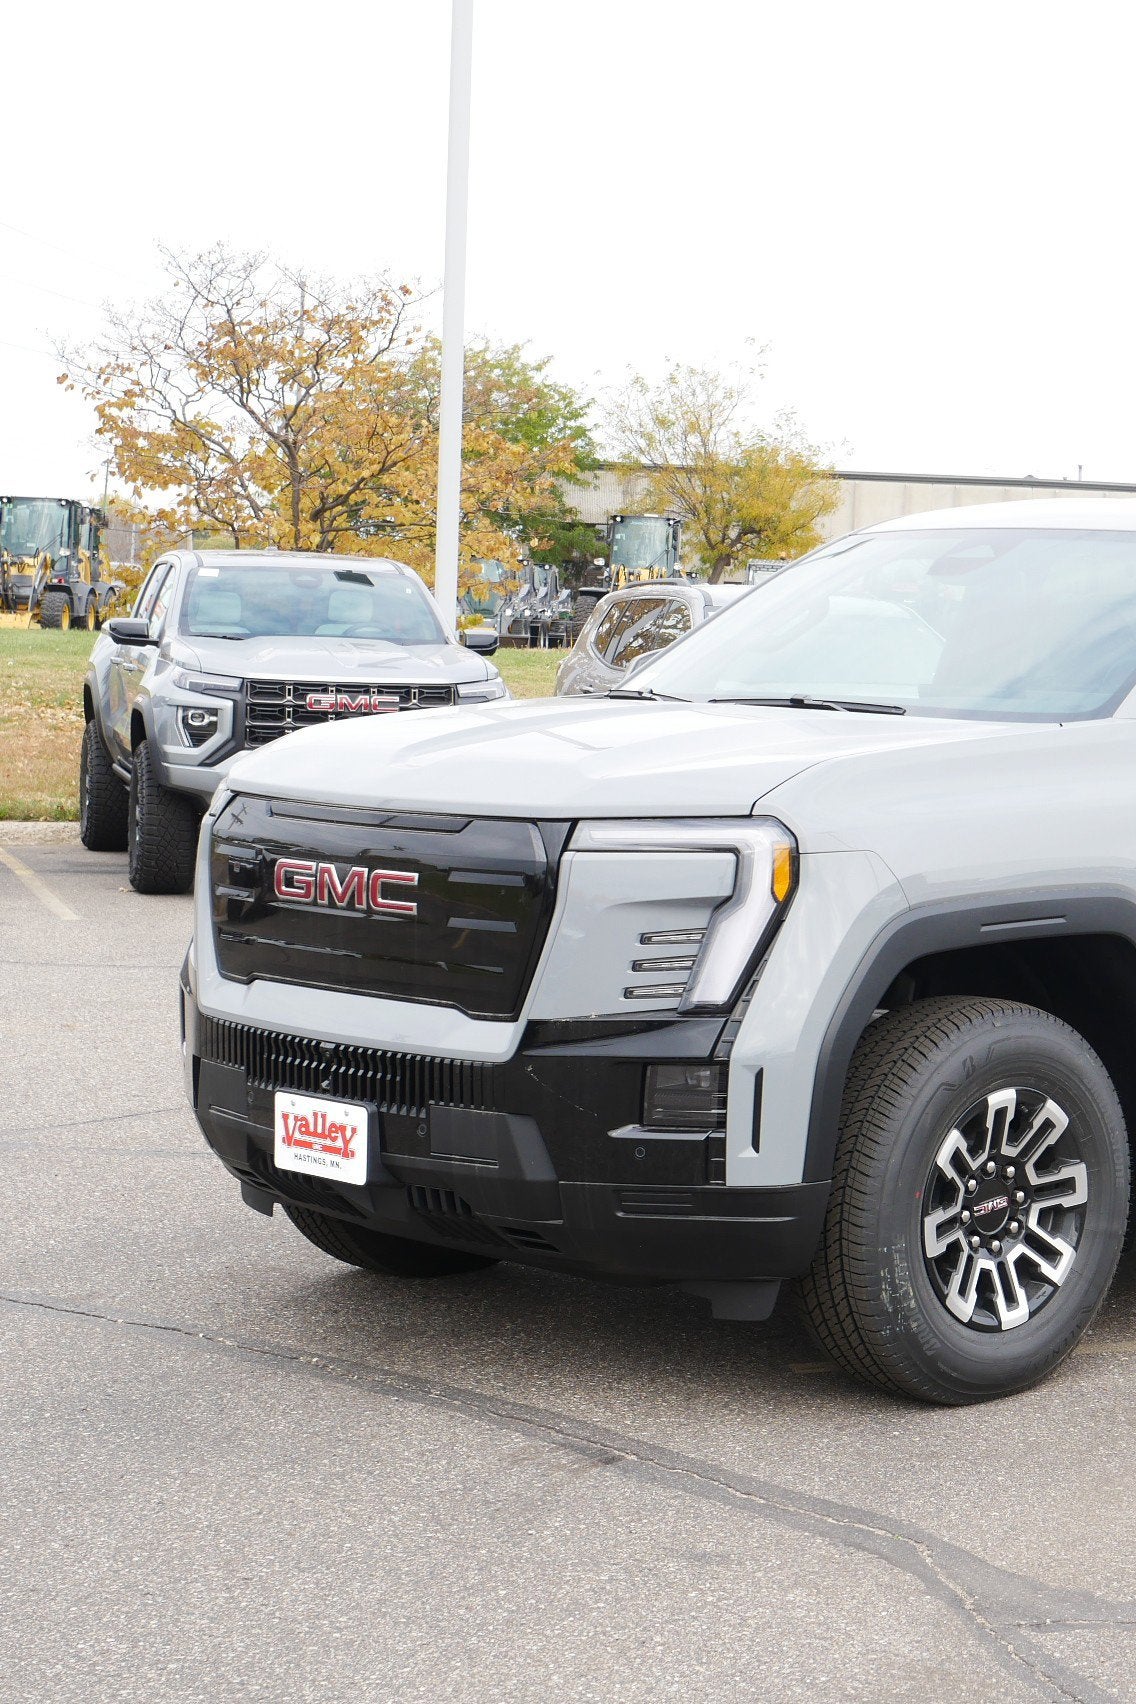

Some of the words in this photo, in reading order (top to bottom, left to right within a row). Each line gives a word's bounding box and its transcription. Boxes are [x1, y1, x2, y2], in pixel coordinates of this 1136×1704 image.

[306, 694, 400, 713] GMC
[274, 858, 420, 916] GMC
[281, 1110, 357, 1159] Valley
[293, 1152, 329, 1168] HASTINGS,
[973, 1196, 1009, 1218] GMC
